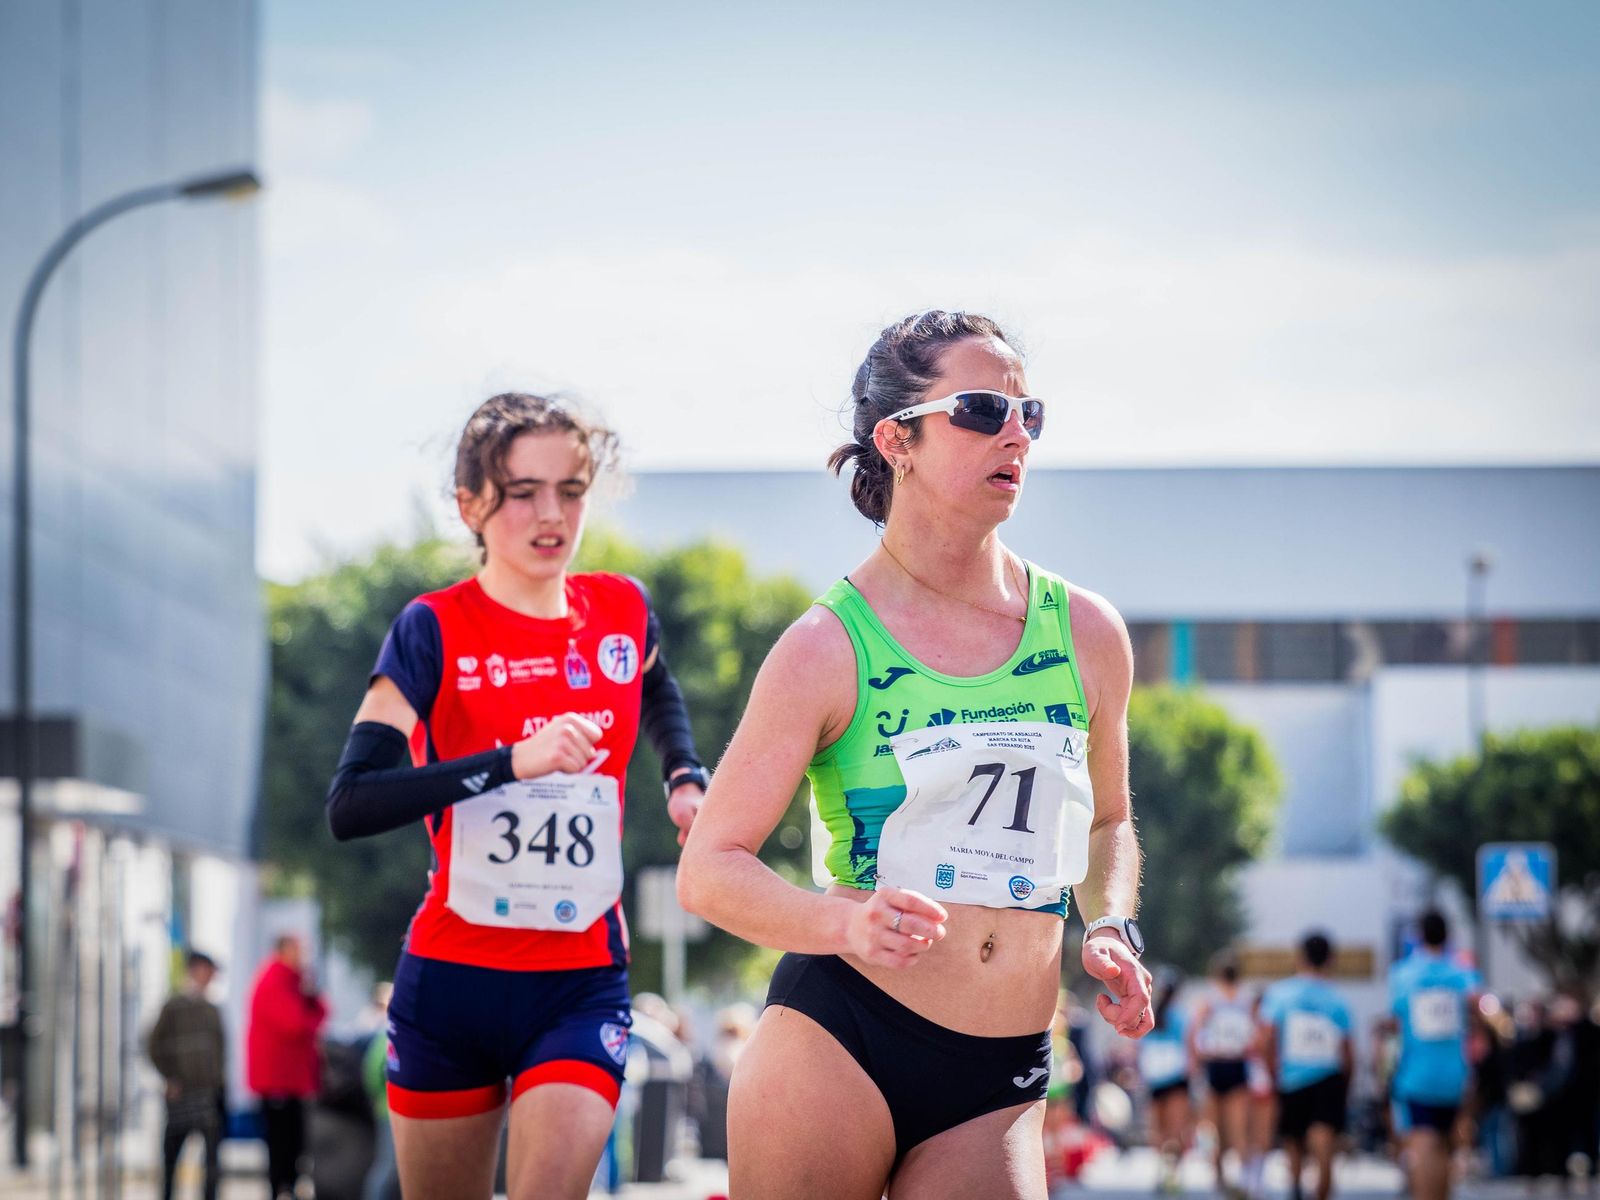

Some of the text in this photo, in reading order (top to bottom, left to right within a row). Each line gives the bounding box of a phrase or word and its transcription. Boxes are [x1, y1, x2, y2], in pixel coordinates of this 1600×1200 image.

[961, 702, 1035, 720] Fundación
[967, 763, 1037, 834] 71
[488, 810, 594, 868] 348
[950, 846, 1035, 865] MARIA MOYA DEL CAMPO
